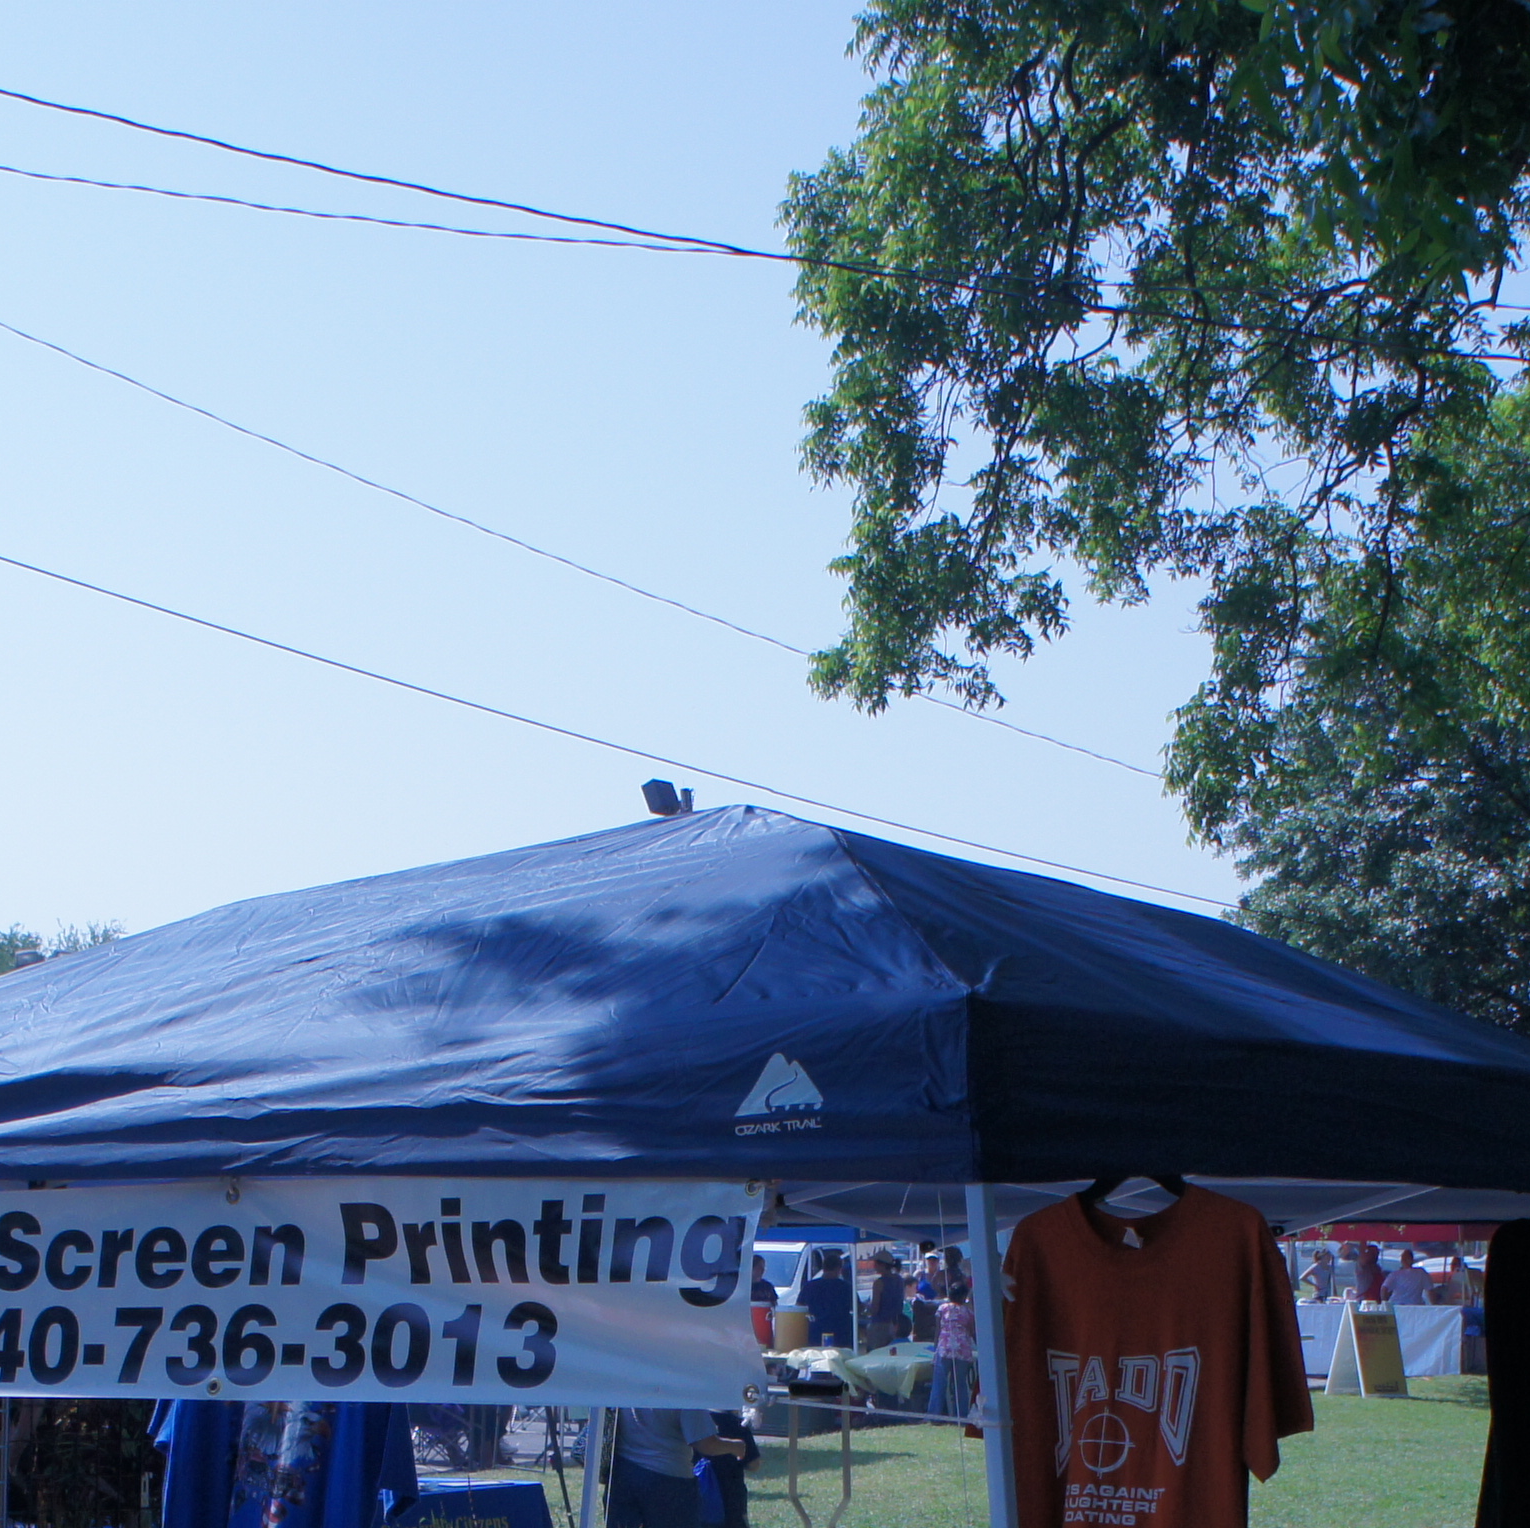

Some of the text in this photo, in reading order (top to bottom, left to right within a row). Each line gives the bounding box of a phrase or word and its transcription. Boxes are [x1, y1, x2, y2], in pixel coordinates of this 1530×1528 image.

[734, 1119, 822, 1136] OZARK TRAIL
[339, 1193, 748, 1308] Printing
[1046, 1346, 1201, 1478] TADD
[1083, 1484, 1166, 1500] AGAINST
[1065, 1511, 1136, 1526] DATING
